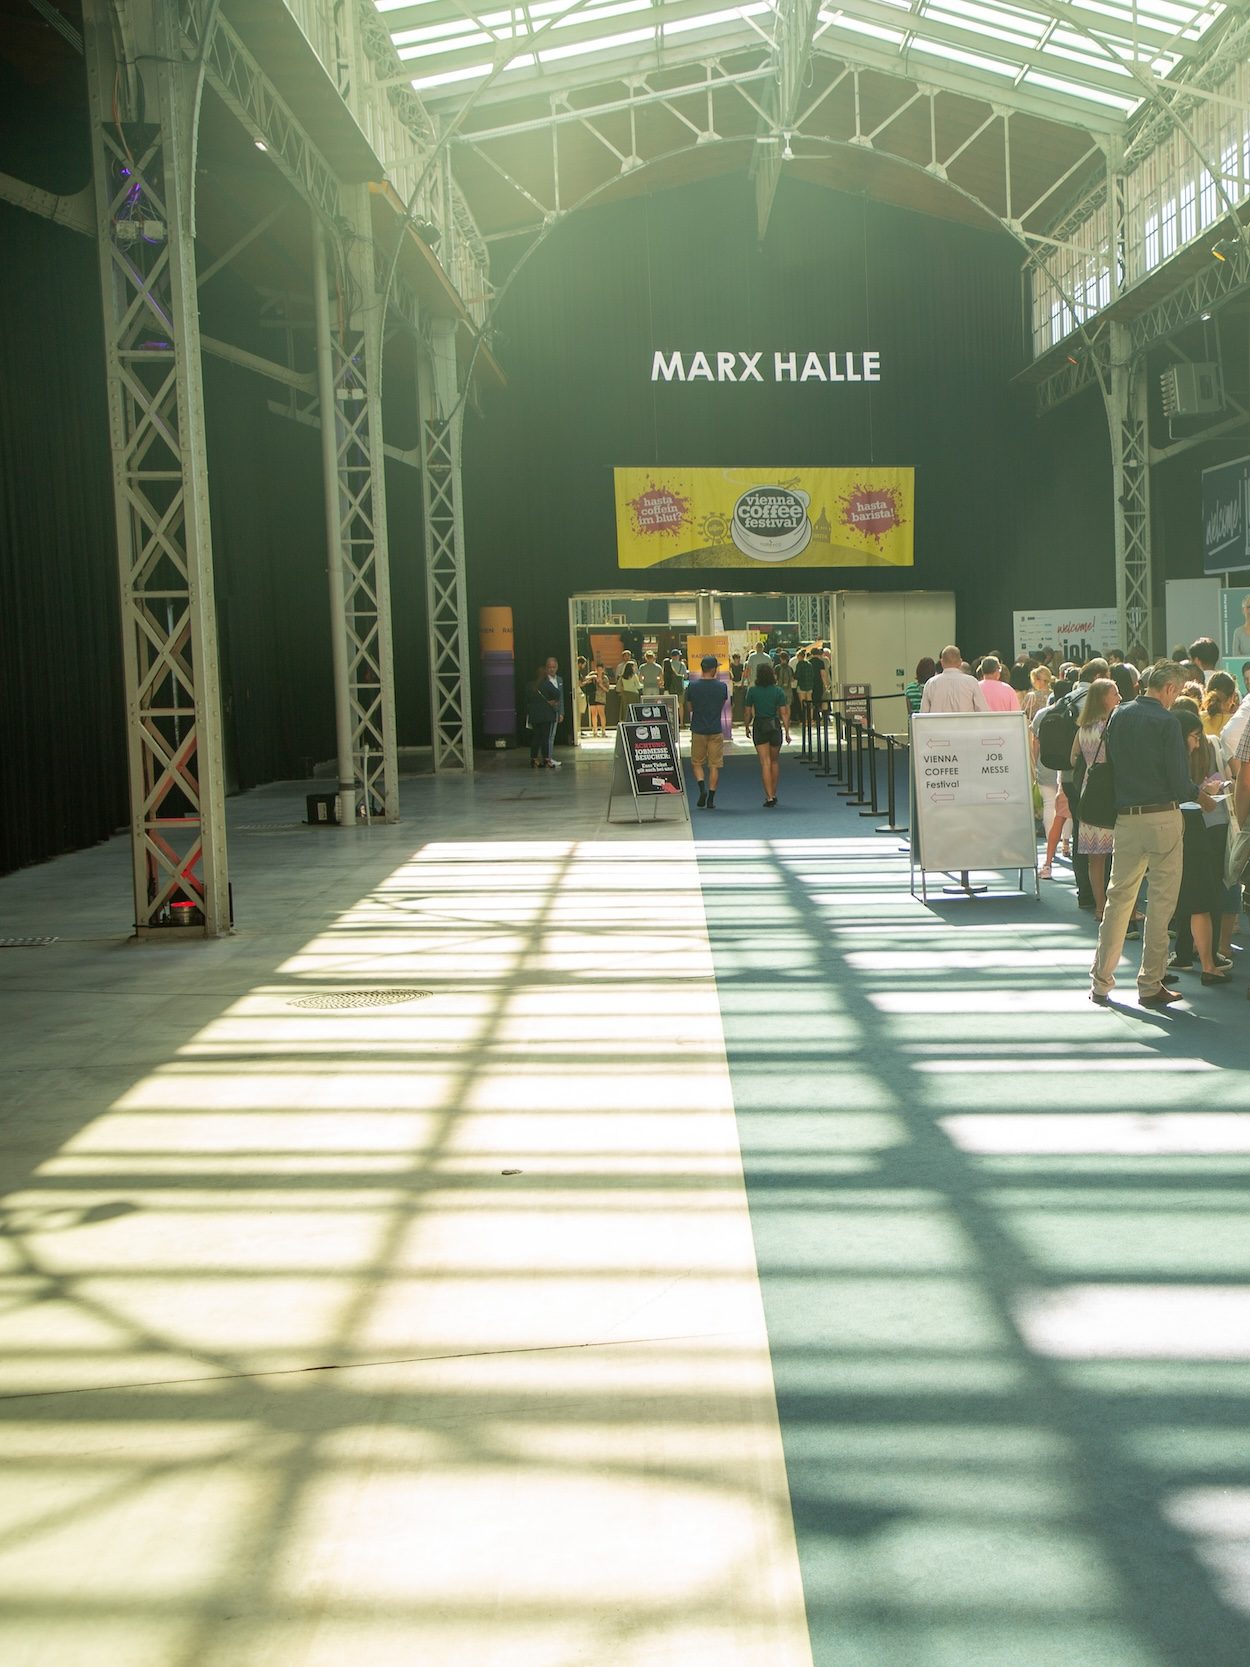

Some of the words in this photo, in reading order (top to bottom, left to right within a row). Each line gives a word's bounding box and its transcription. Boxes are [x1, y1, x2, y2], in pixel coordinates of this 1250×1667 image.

[651, 351, 764, 382] MARX
[774, 351, 881, 382] HALLE
[643, 496, 673, 507] hasta
[745, 493, 796, 506] vienna
[641, 504, 679, 516] coffein
[738, 504, 802, 519] coffee
[856, 501, 887, 511] hasta
[639, 515, 654, 525] im
[655, 512, 682, 524] blut?
[852, 508, 895, 522] barista!
[744, 517, 798, 528] festival
[1057, 615, 1096, 634] welcome!
[923, 754, 958, 763] VIENNA
[986, 753, 1003, 761] JOB
[925, 767, 959, 776] COFFEE
[981, 765, 1009, 774] MESSE
[926, 780, 960, 789] Festival
